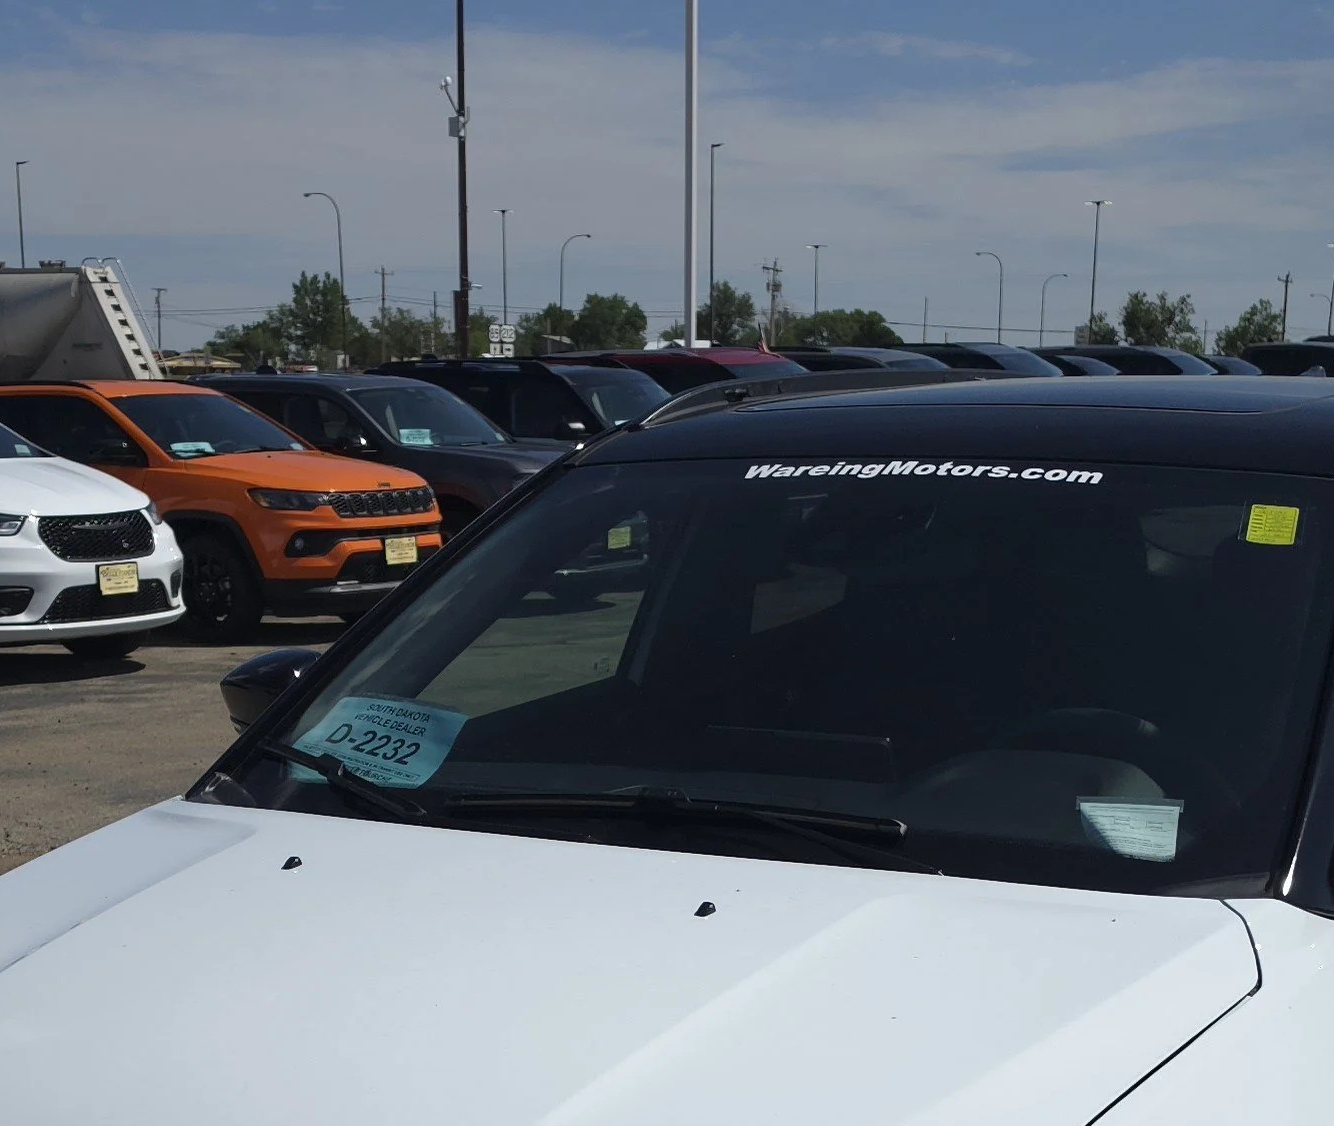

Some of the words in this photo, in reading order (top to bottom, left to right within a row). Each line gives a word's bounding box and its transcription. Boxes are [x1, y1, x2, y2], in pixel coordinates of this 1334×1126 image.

[501, 327, 514, 339] 212
[743, 460, 1104, 485] WareingMotors.com
[354, 713, 392, 728] VEHICLE
[390, 720, 427, 738] DEALER
[366, 703, 396, 717] SOUTH
[395, 708, 431, 724] DAKOTA
[325, 722, 421, 766] D-2232
